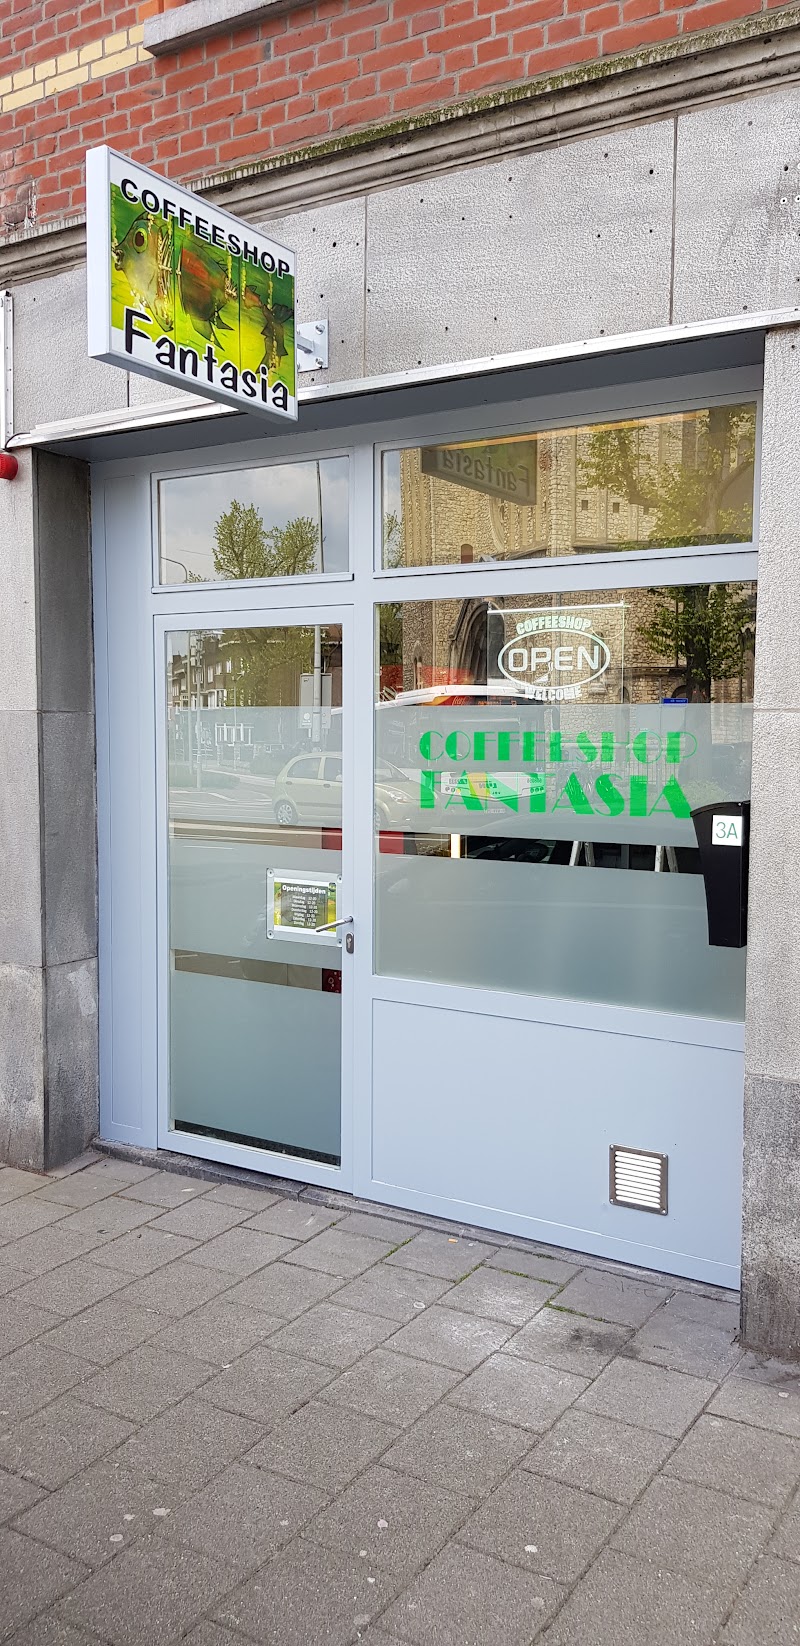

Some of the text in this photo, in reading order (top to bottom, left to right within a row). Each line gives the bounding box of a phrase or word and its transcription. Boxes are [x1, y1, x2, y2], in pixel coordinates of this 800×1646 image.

[121, 178, 290, 278] COFFEESHOP
[125, 307, 288, 412] Fantasia
[516, 615, 591, 634] COFFEESHOP
[508, 645, 599, 672] OPEN
[524, 685, 582, 700] WELCOME
[419, 730, 698, 764] COFFEESHOP
[420, 769, 692, 819] FANTASIA
[715, 821, 738, 839] 3A
[282, 884, 326, 894] Openingstijden
